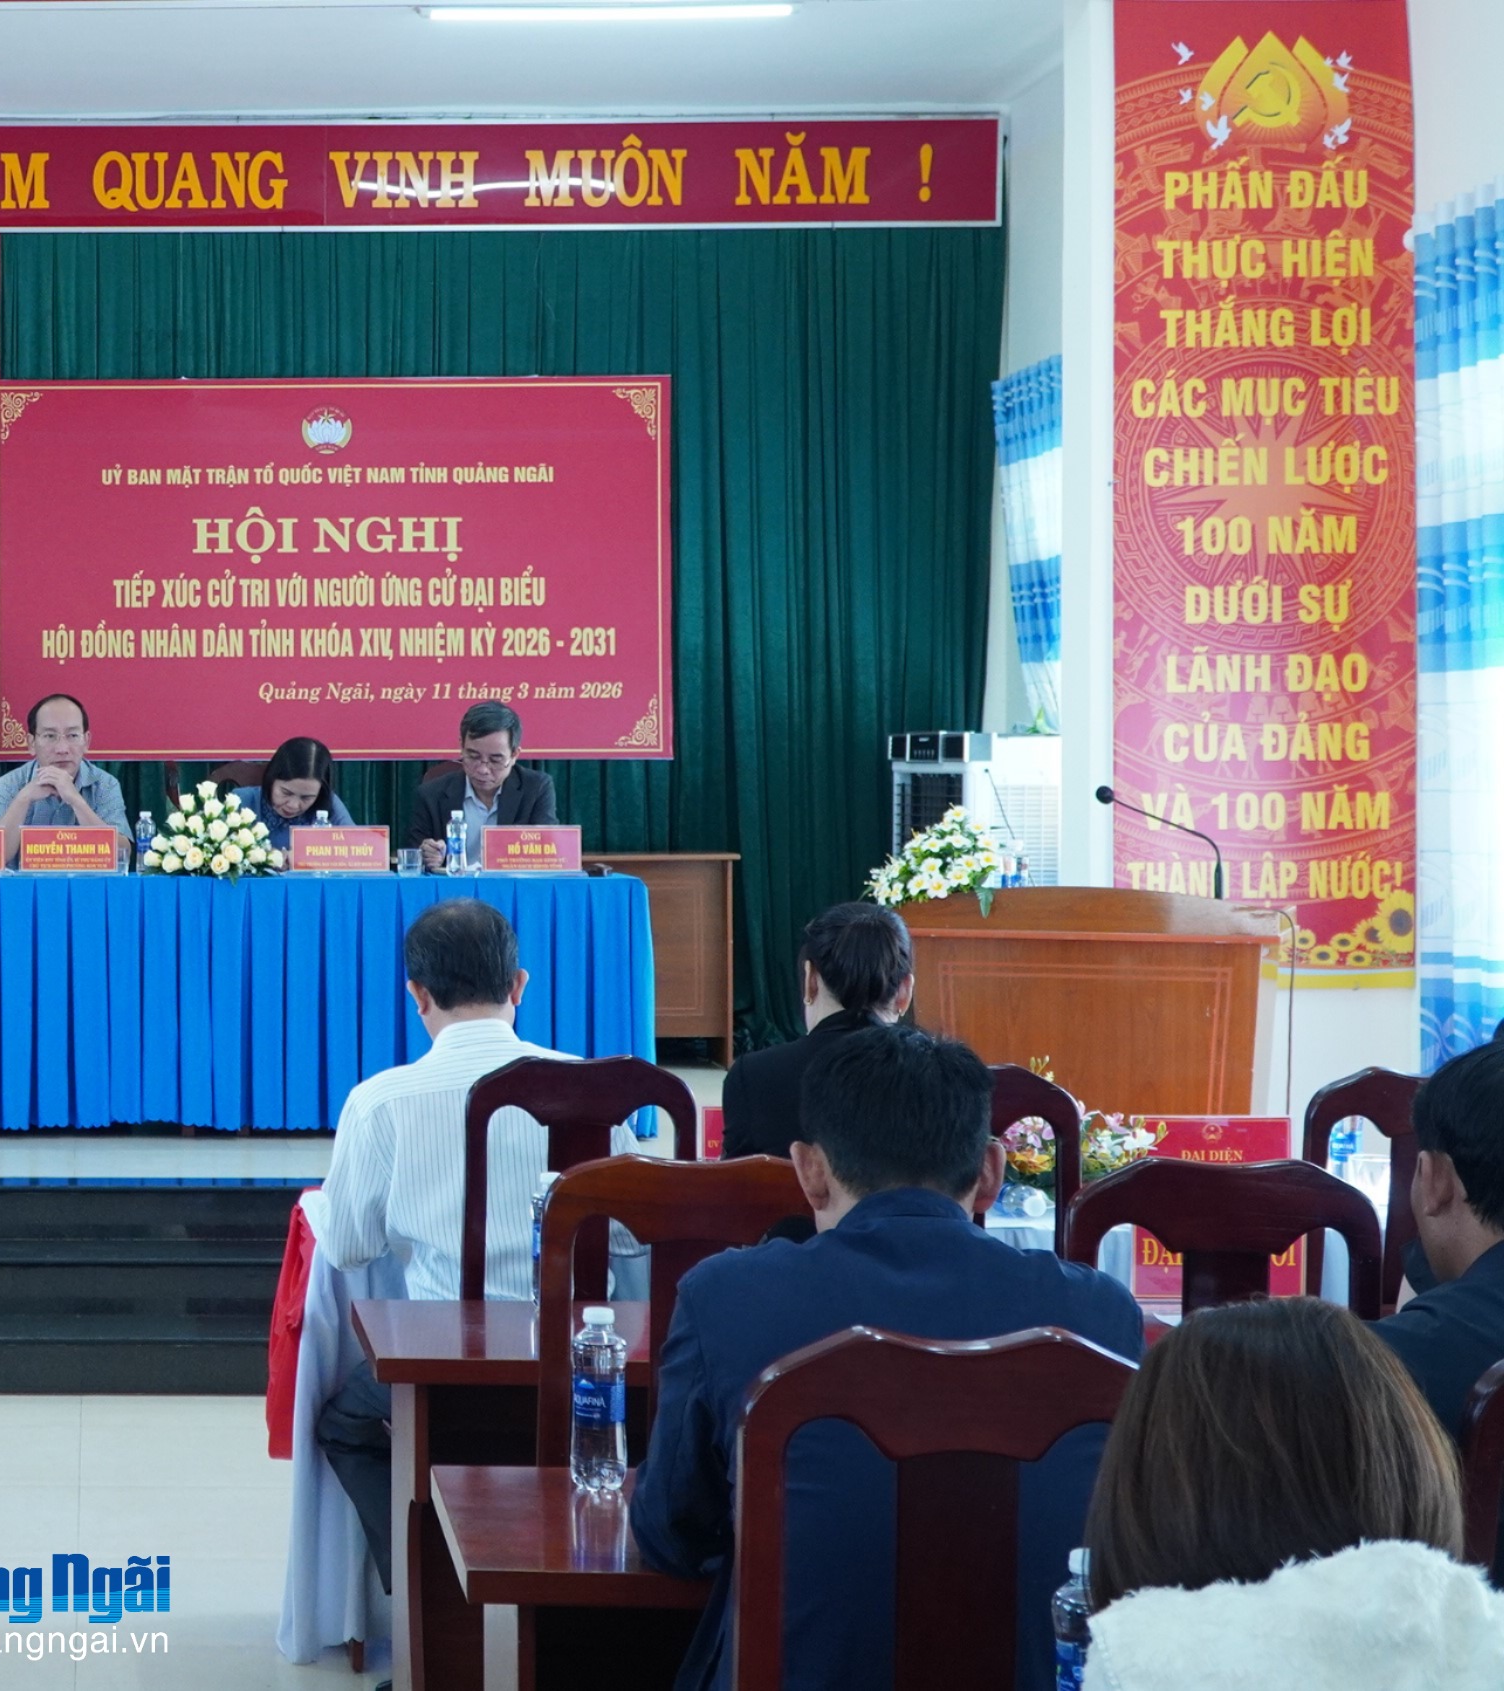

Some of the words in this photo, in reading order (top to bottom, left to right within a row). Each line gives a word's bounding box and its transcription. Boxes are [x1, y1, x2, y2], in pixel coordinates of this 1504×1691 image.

[92, 150, 288, 212] QUANG
[329, 150, 479, 208] VINH
[524, 133, 687, 207] MUÔN
[735, 131, 870, 205] NĂM
[1165, 156, 1273, 210] PHẤN
[1287, 155, 1369, 209] ĐẤU
[1157, 234, 1267, 289] THỰC
[1282, 230, 1375, 287] HIỆN
[1160, 295, 1295, 348] THẮNG
[1310, 302, 1371, 356] LỢI
[1132, 370, 1207, 418] CÁC
[1222, 377, 1307, 425] MỤC
[1319, 367, 1400, 416] TIÊU
[127, 469, 161, 485] BAN
[166, 465, 201, 488] MẶT
[206, 465, 249, 488] TRẬN
[254, 462, 275, 485] TỔ
[279, 462, 323, 484] QUỐC
[327, 464, 362, 487] VIỆT
[366, 467, 405, 483] NAM
[410, 462, 448, 483] TỈNH
[452, 461, 509, 484] QUẢNG
[514, 463, 554, 483] NGÃI
[1144, 432, 1269, 487] CHIẾN
[1285, 441, 1389, 494] LƯỢC
[192, 506, 298, 564] HỘI
[313, 516, 463, 562] NGHỊ
[1176, 515, 1252, 556] 100
[1267, 508, 1358, 555] NĂM
[113, 570, 155, 608] TIẾP
[161, 572, 201, 608] XÚC
[207, 569, 236, 608] CỬ
[240, 578, 270, 607] TRI
[276, 572, 307, 607] VỚI
[314, 571, 375, 607] NGƯỜI
[381, 571, 422, 607] ỨNG
[428, 567, 457, 607] CỬ
[460, 577, 494, 613] ĐẠI
[500, 565, 546, 606] BIỂU
[1184, 575, 1283, 625] DƯỚI
[1298, 579, 1352, 632] SỰ
[42, 624, 75, 665] HỘI
[80, 619, 135, 659] ĐỒNG
[141, 623, 196, 658] NHÂN
[202, 623, 244, 658] DÂN
[249, 619, 295, 657] TỈNH
[301, 623, 354, 657] KHÓA
[359, 628, 393, 661] XIV,
[399, 621, 465, 664] NHIỆM
[471, 621, 497, 656] KỲ
[502, 627, 551, 657] 2026
[569, 627, 616, 657] 2031
[258, 681, 322, 704] Quảng
[326, 682, 375, 703] Ngãi,
[380, 685, 427, 703] ngày
[432, 683, 452, 700] 11
[458, 681, 512, 703] tháng
[518, 683, 529, 700] 3
[533, 683, 575, 700] năm
[579, 681, 623, 699] 2026
[1166, 646, 1271, 694] LÃNH
[1286, 653, 1368, 701] ĐẠO
[1163, 711, 1247, 762] CỦA
[1261, 711, 1370, 762] ĐẢNG
[1142, 784, 1194, 831] VÀ
[1211, 791, 1286, 831] 100
[1301, 784, 1390, 830] NĂM
[65, 843, 96, 855] THANH
[306, 845, 331, 857] PHAN
[334, 845, 348, 858] THỊ
[520, 830, 541, 841] ÔNG
[1242, 851, 1297, 908] LẬP
[1309, 851, 1403, 899] NƯỚC!
[1209, 1147, 1243, 1164] DIỆN
